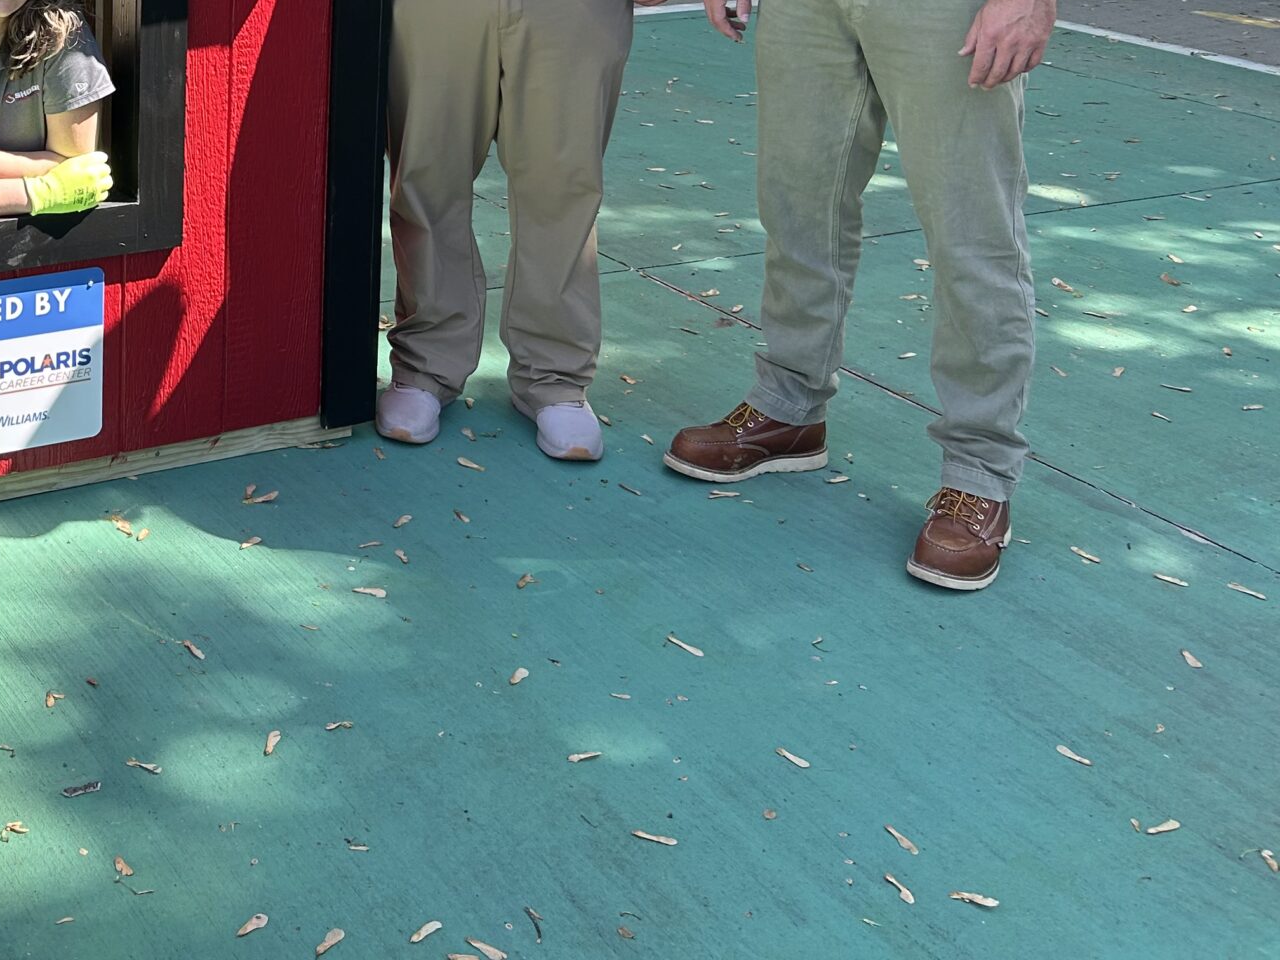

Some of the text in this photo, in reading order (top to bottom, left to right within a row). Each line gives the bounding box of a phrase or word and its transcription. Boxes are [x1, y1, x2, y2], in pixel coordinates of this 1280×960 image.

[35, 288, 72, 316] BY
[0, 347, 91, 379] POLARIS
[0, 367, 91, 392] CAREER CENTER
